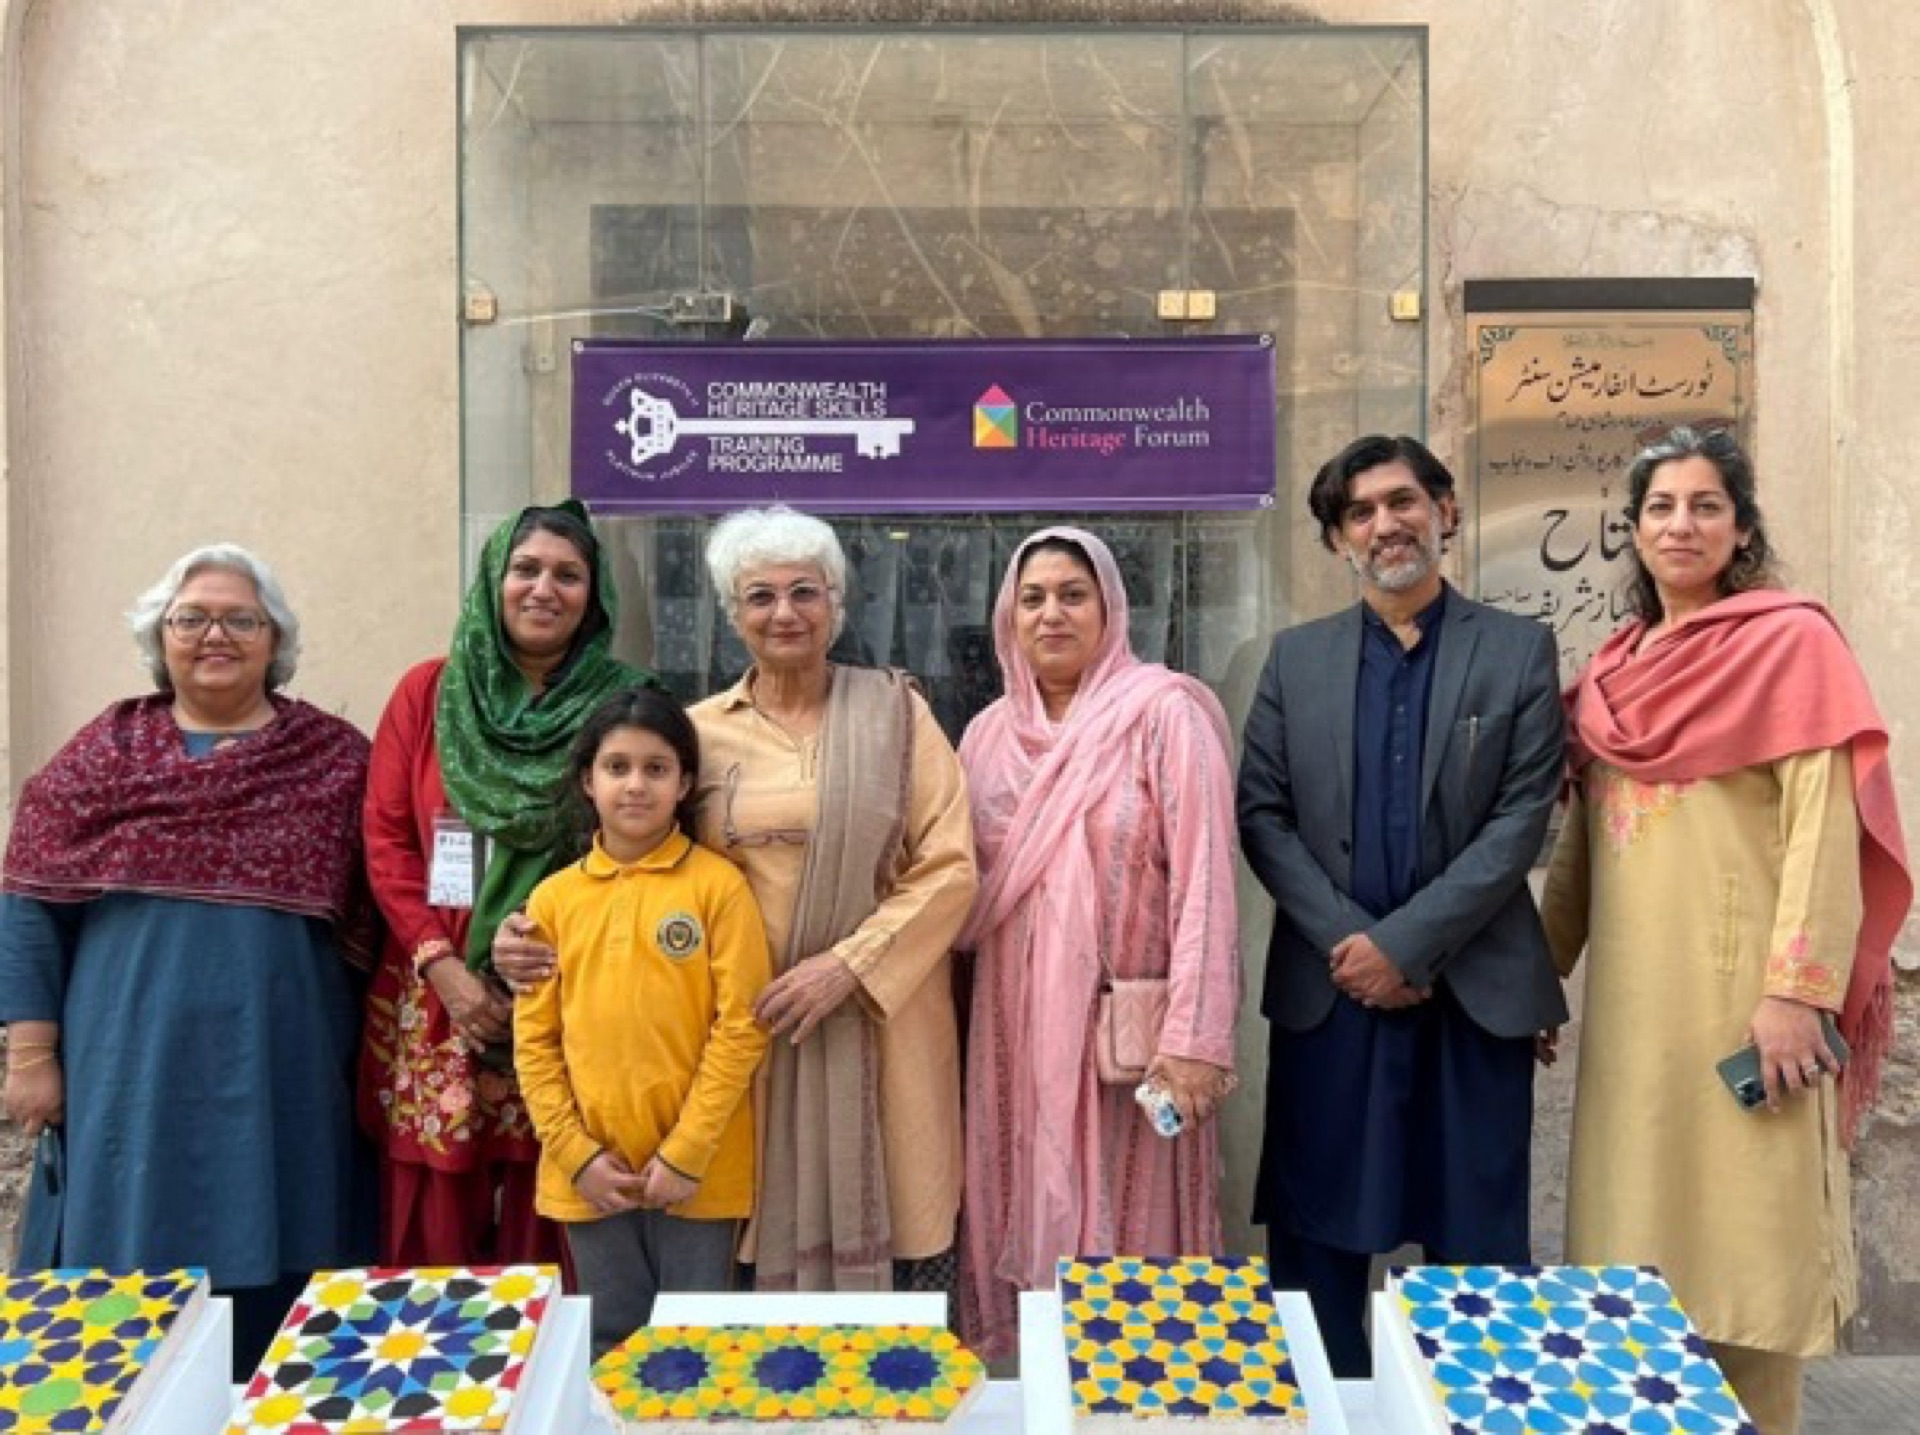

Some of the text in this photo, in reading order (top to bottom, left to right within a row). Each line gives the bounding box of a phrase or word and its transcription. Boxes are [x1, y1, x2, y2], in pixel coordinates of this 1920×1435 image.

[707, 381, 887, 400] COMMONWEALTH
[707, 400, 887, 418] HERITAGE SKILLS
[1025, 396, 1211, 423] Commonwealth
[707, 436, 804, 453] TRAINING
[1025, 424, 1211, 456] Heritage Forum
[707, 453, 843, 473] PROGRAMME
